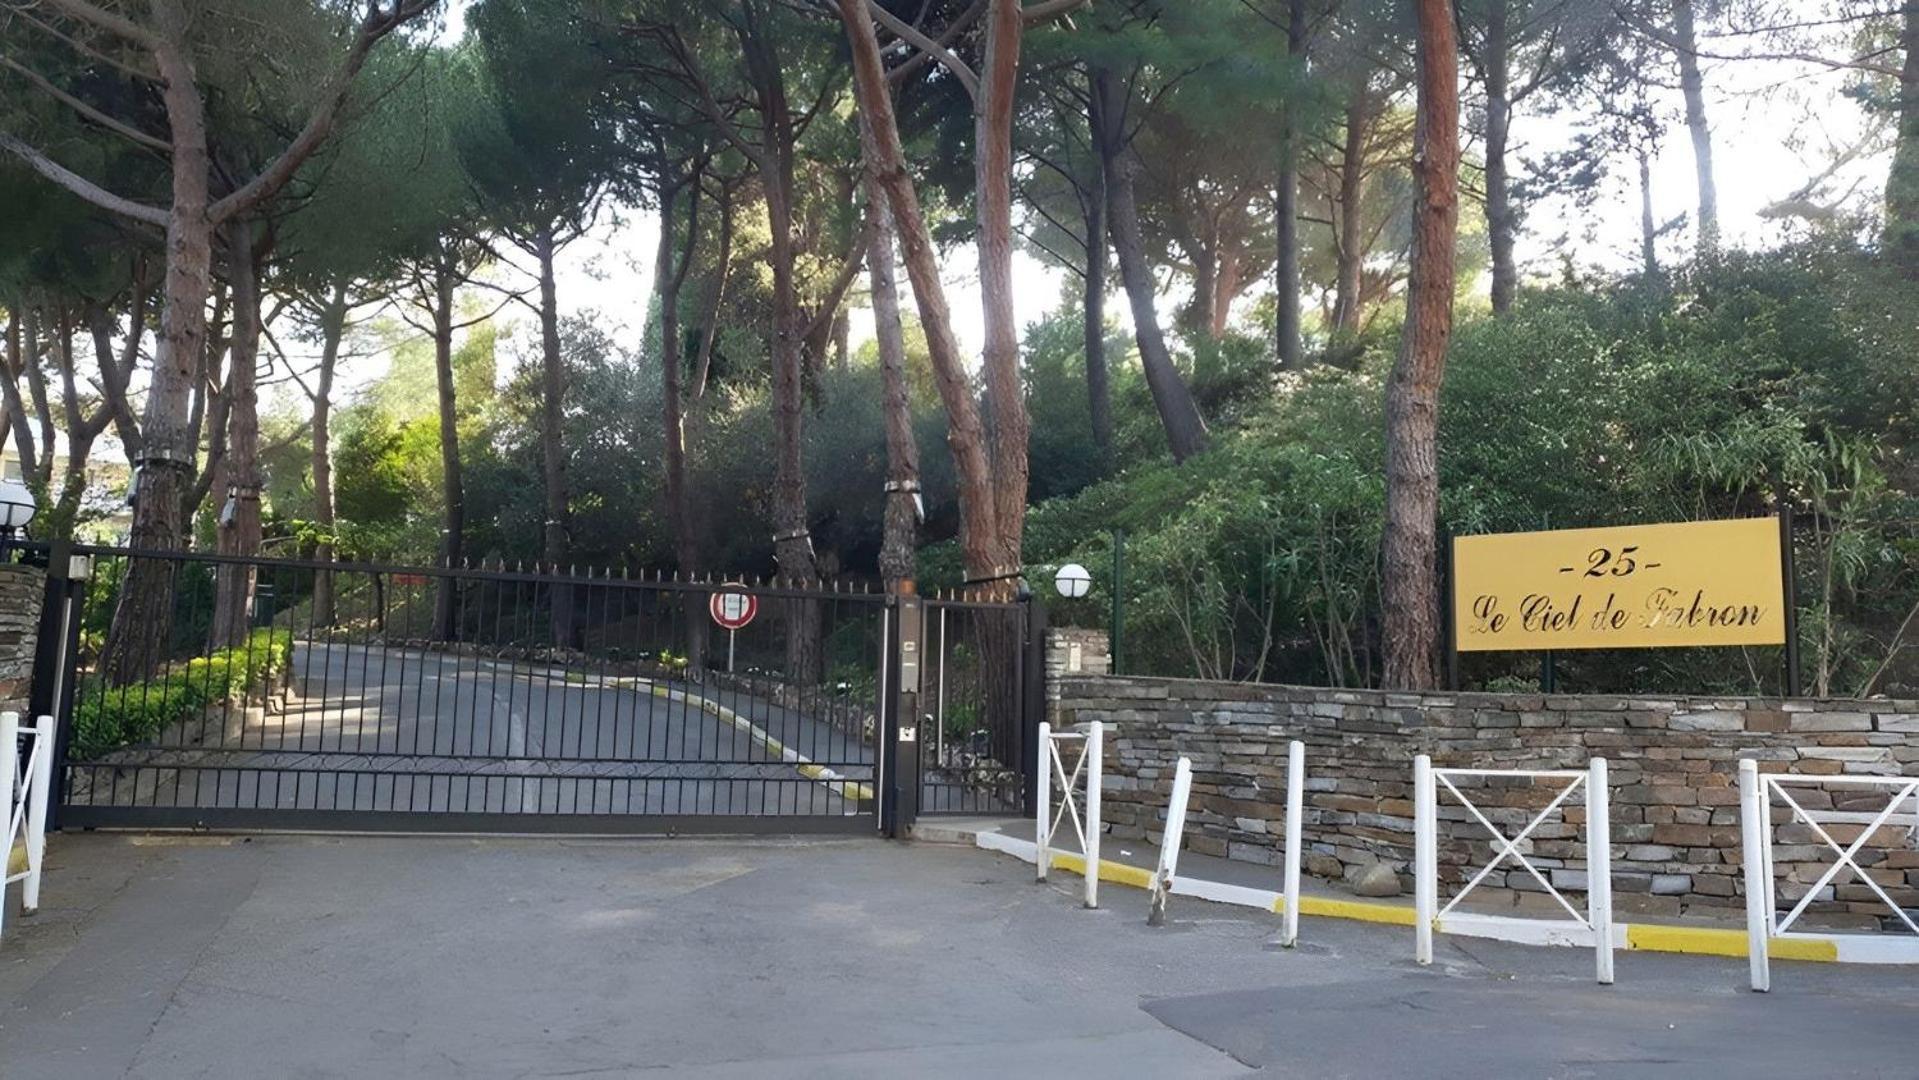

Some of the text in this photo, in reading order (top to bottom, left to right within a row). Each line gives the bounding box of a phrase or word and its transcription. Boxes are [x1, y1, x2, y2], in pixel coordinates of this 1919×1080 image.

[1469, 587, 1767, 635] Le Ciel de Fabron
